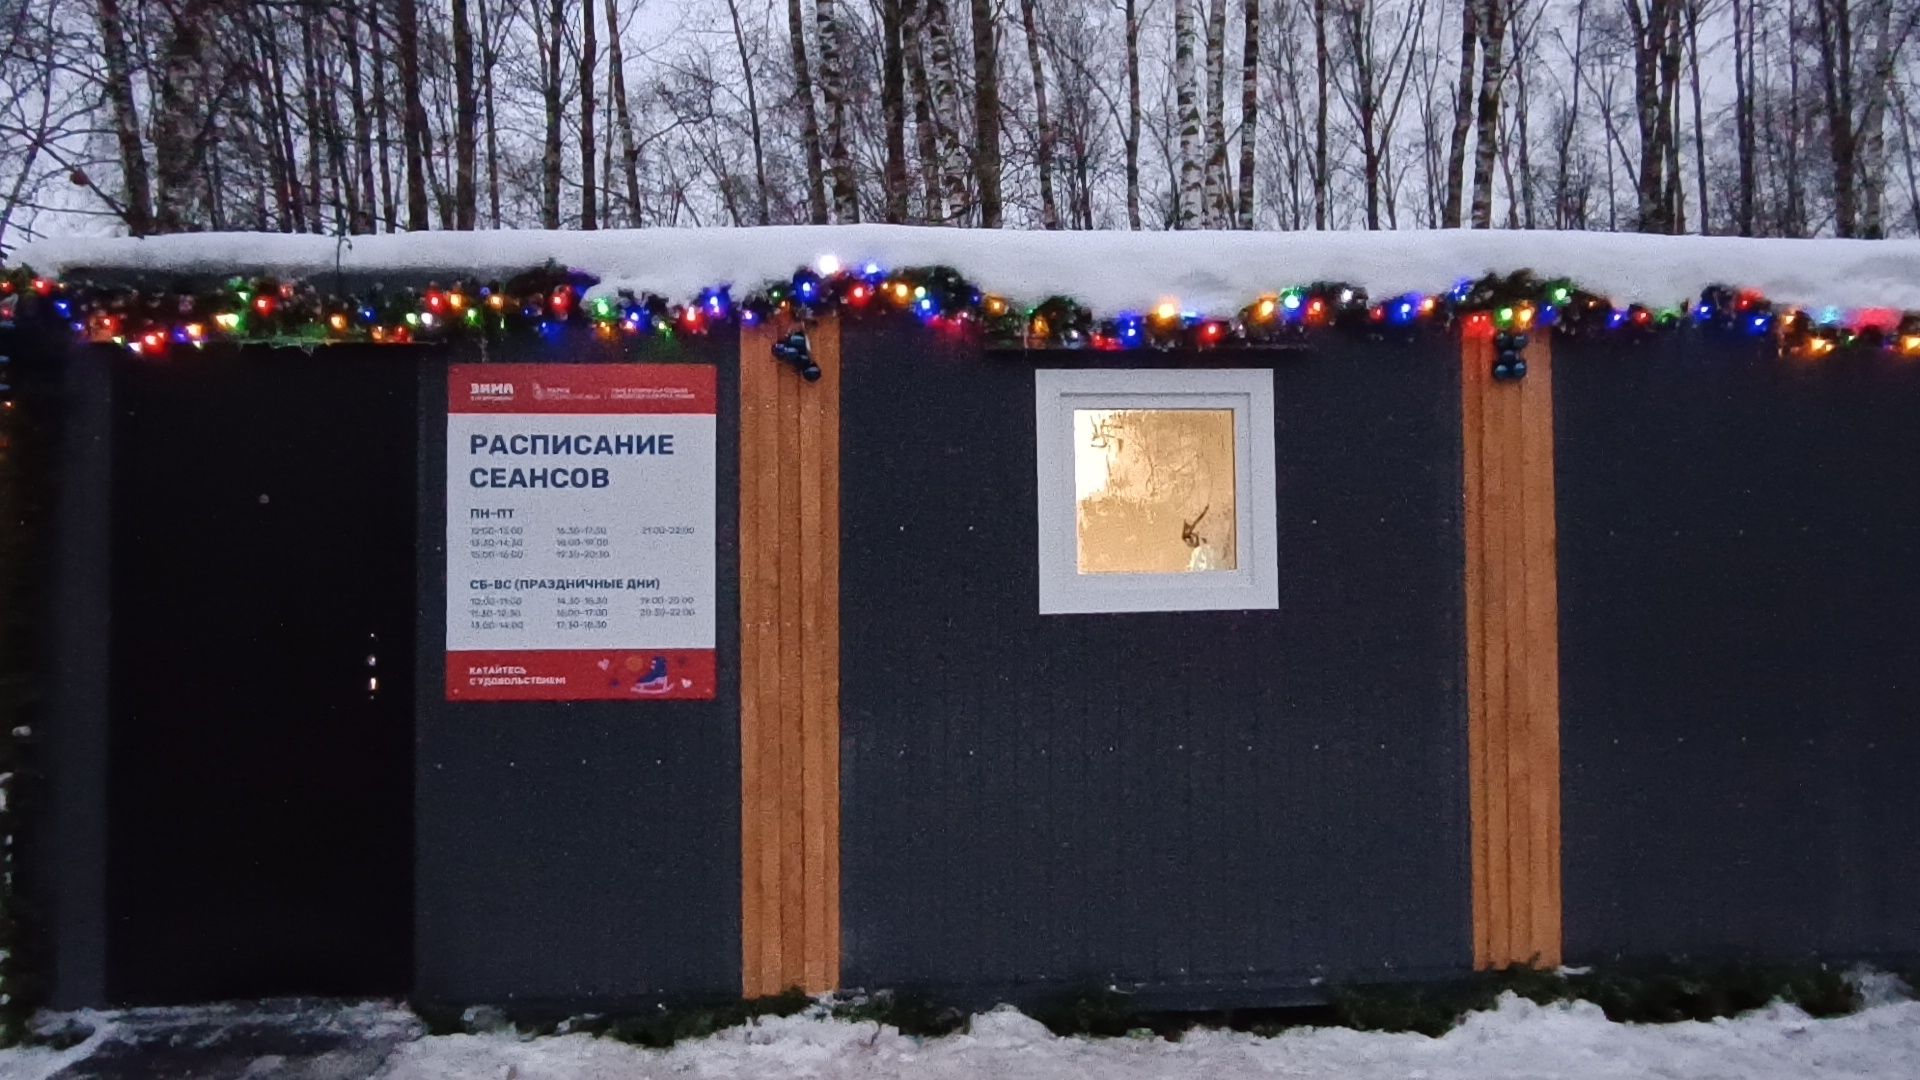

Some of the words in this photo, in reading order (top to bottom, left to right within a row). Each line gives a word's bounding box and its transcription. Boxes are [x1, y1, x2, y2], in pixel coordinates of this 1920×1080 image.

[470, 434, 674, 456] РАСПИСАНИЕ
[469, 467, 610, 489] СЕАНСОВ
[514, 579, 624, 591] (ПРАЗДНИЧНЫЕ
[626, 579, 660, 591] ДНИ)
[469, 665, 526, 674] КАТАЙТЕСЬ
